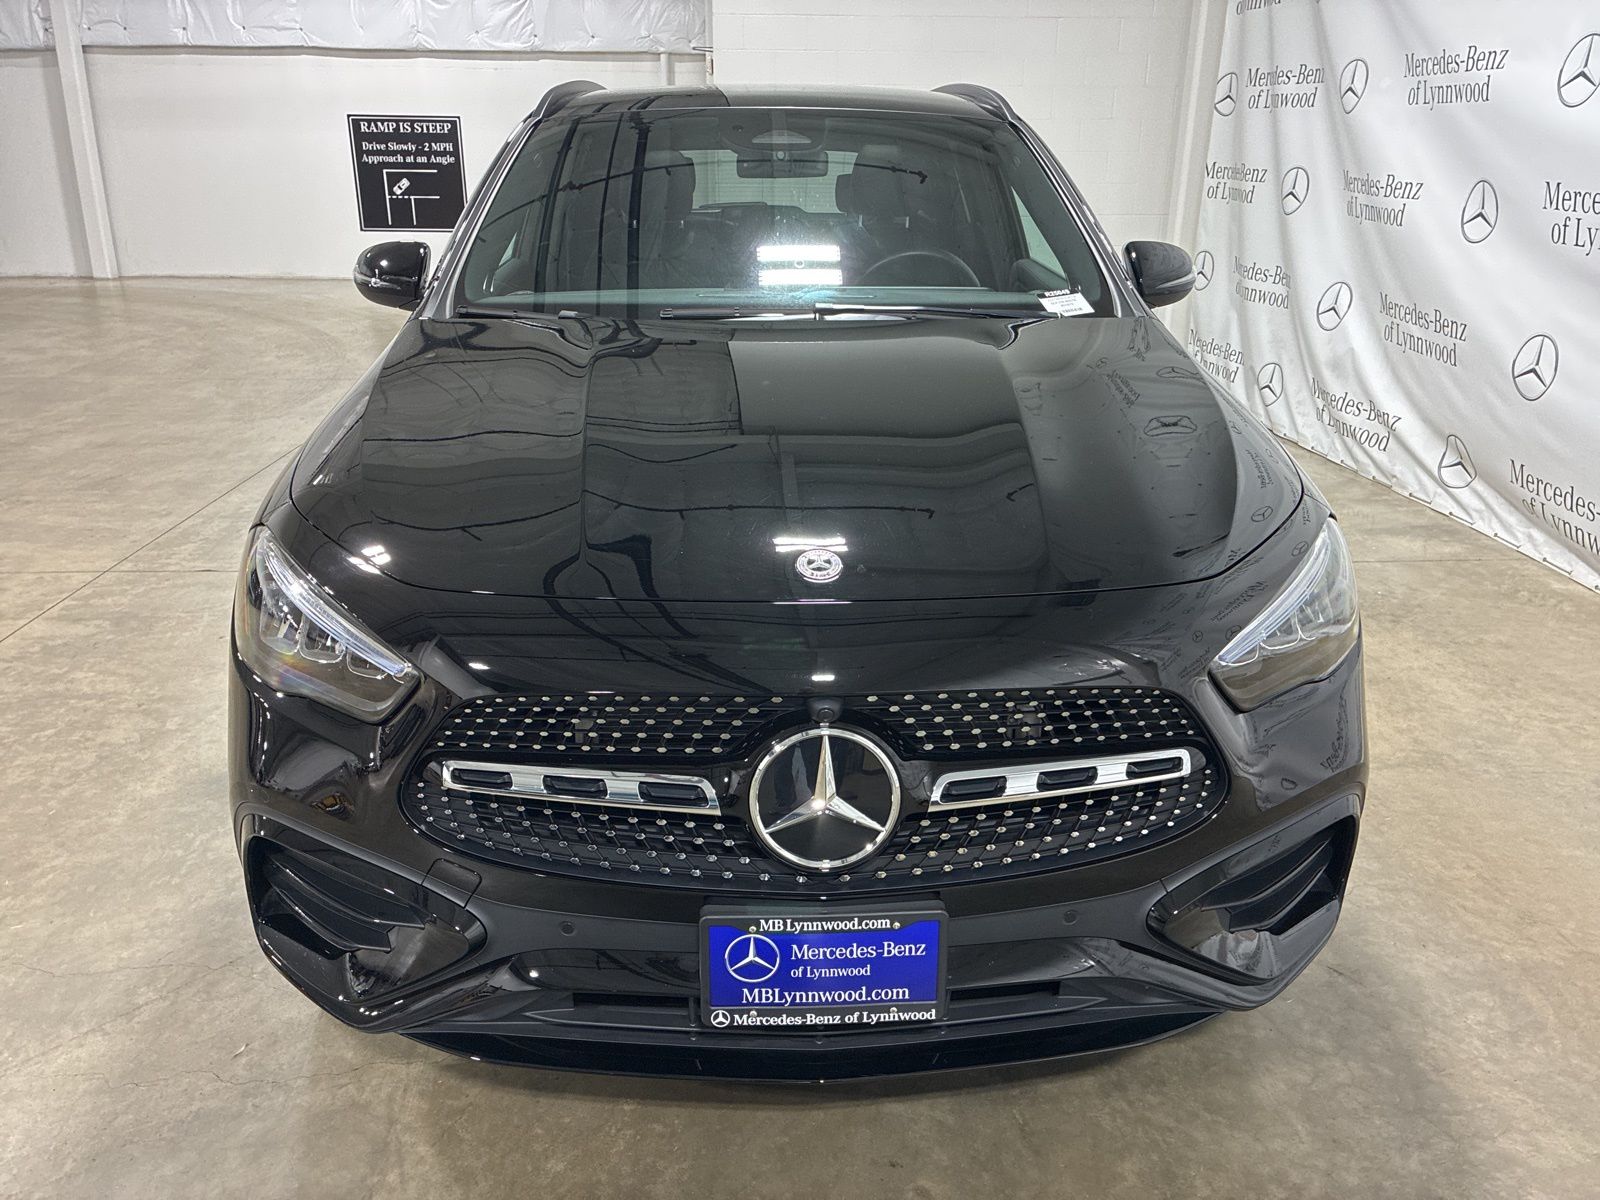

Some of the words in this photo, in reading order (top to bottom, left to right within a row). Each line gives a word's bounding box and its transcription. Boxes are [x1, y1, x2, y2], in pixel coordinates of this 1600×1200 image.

[1403, 45, 1509, 78] Mercedes-Benz
[1248, 89, 1264, 110] of
[1408, 80, 1421, 106] of
[1423, 75, 1491, 111] Lynnwood
[360, 121, 397, 133] RAMP
[399, 122, 412, 133] IS
[414, 122, 452, 134] STEEP
[362, 141, 386, 151] Drive
[387, 142, 417, 152] Slowly
[424, 143, 430, 151] 2
[431, 143, 454, 152] MPH
[362, 154, 404, 164] Approach
[405, 154, 415, 163] at
[429, 155, 456, 165] Angle
[1207, 181, 1221, 199] of
[1343, 169, 1424, 200] Mercedes-Benz
[1354, 196, 1407, 228] Lynnwood
[1551, 216, 1571, 245] of
[1573, 217, 1600, 256] Ly
[1379, 291, 1468, 342] Mercedes-Benz
[1384, 321, 1394, 343] of
[1396, 322, 1458, 367] Lynnwood
[1316, 404, 1327, 424] of
[1521, 497, 1540, 519] of
[790, 941, 927, 960] Mercedes-Benz
[790, 966, 804, 978] of
[806, 964, 871, 980] Lynnwood
[741, 986, 910, 1007] MBLynnwood.com
[733, 1013, 842, 1027] Mercedes-Benz
[844, 1012, 860, 1023] of
[861, 1008, 937, 1024] Lynnwood
